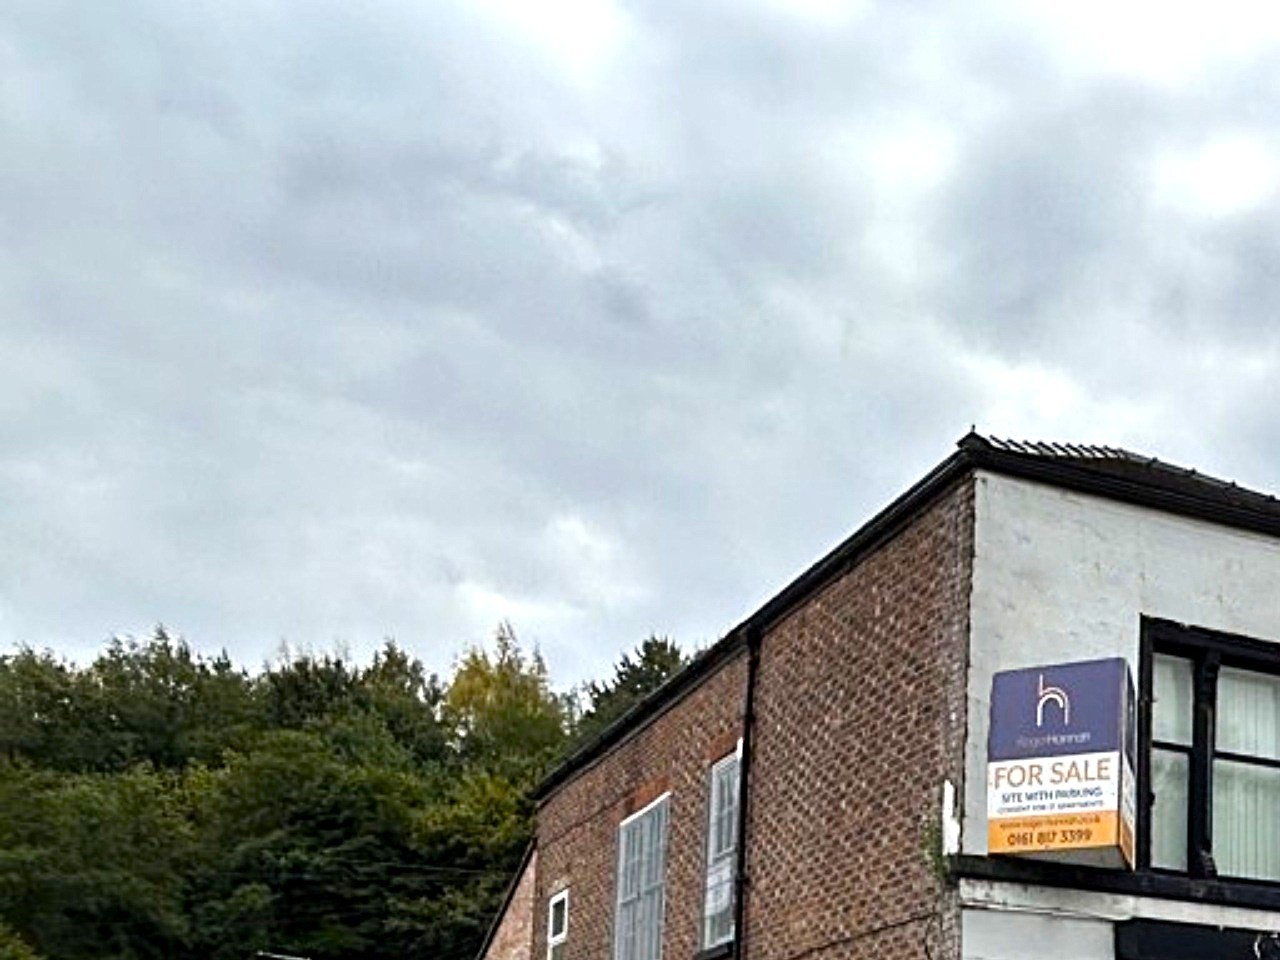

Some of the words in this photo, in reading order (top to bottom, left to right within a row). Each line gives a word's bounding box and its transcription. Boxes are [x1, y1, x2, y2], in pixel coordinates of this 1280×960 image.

[994, 765, 1043, 790] FOR
[1049, 757, 1111, 784] SALE
[1001, 790, 1023, 804] SITE
[1024, 789, 1053, 802] WITH
[1055, 785, 1103, 798] PARKING
[1007, 832, 1033, 847] 0161
